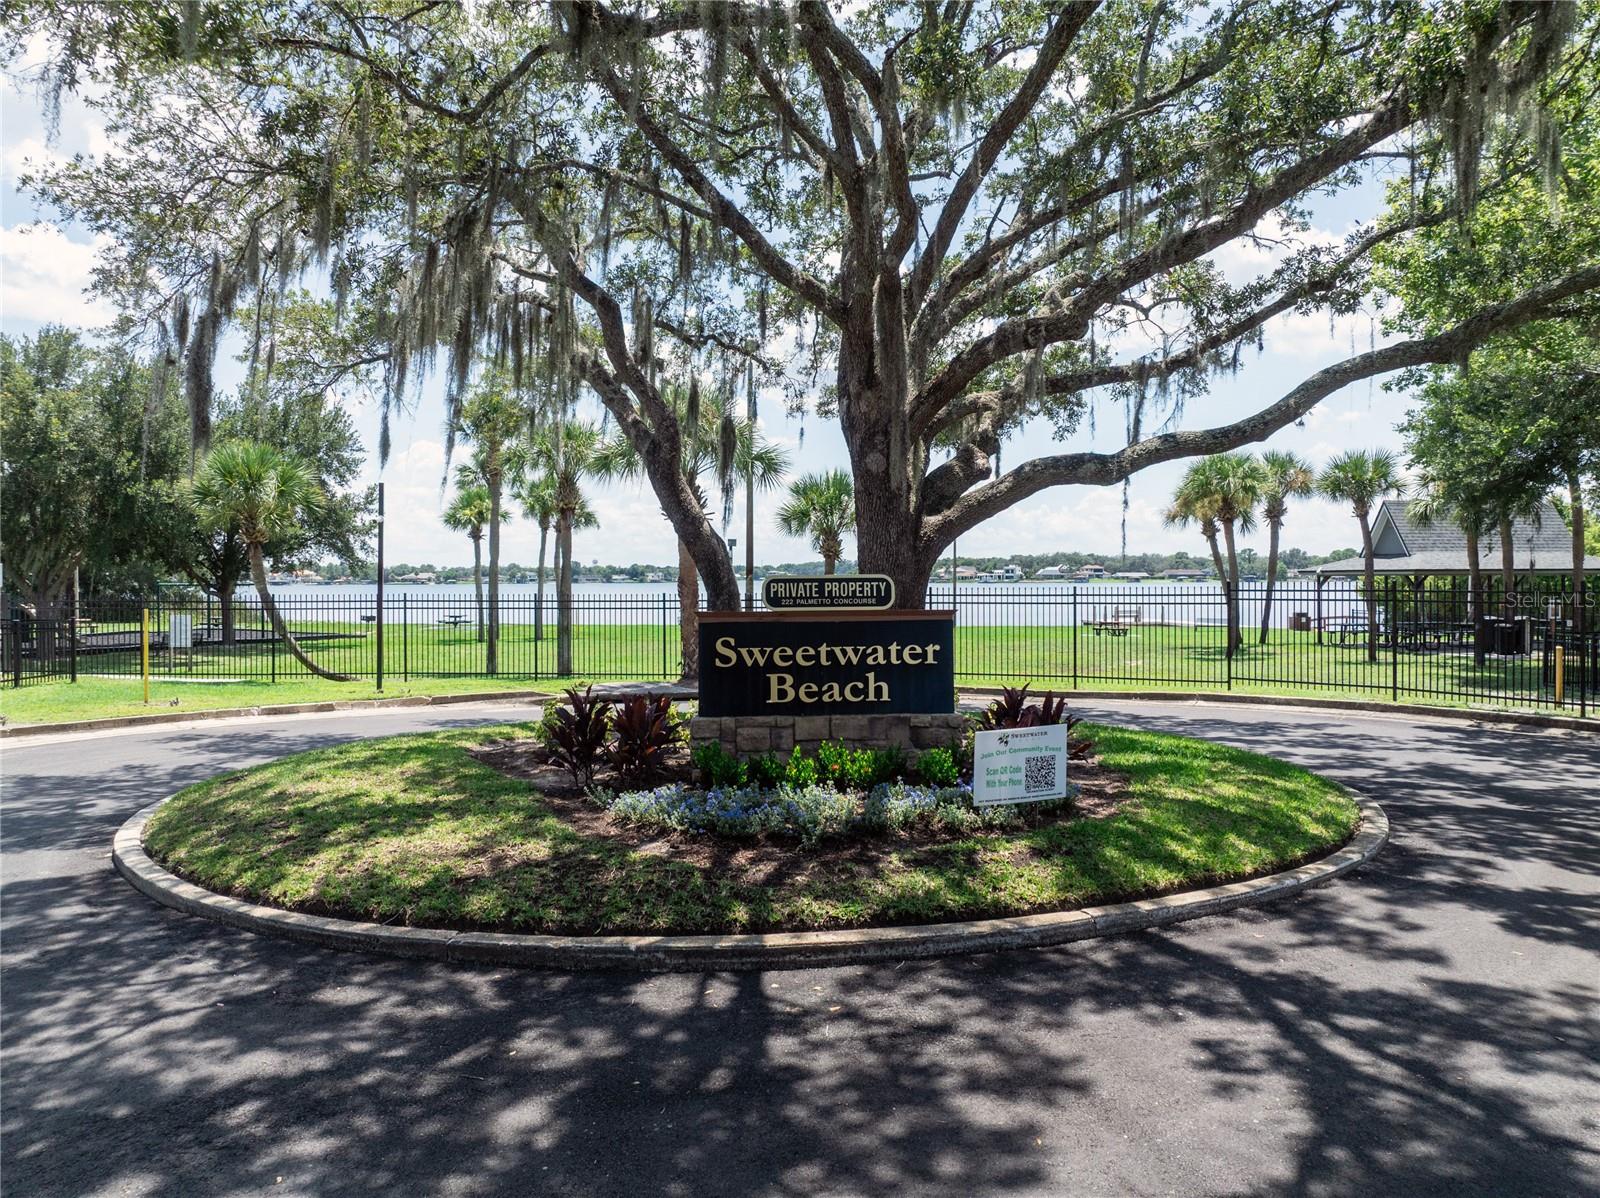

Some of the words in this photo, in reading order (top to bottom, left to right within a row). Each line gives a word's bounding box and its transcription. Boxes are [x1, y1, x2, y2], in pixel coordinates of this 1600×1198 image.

[770, 582, 819, 597] PRIVATE
[825, 582, 886, 597] PROPERTY
[714, 636, 941, 668] Sweetwater
[765, 671, 892, 704] Beach
[980, 752, 994, 760] Join
[1008, 746, 1044, 755] Community
[986, 767, 999, 776] Scan
[1009, 765, 1022, 774] Code
